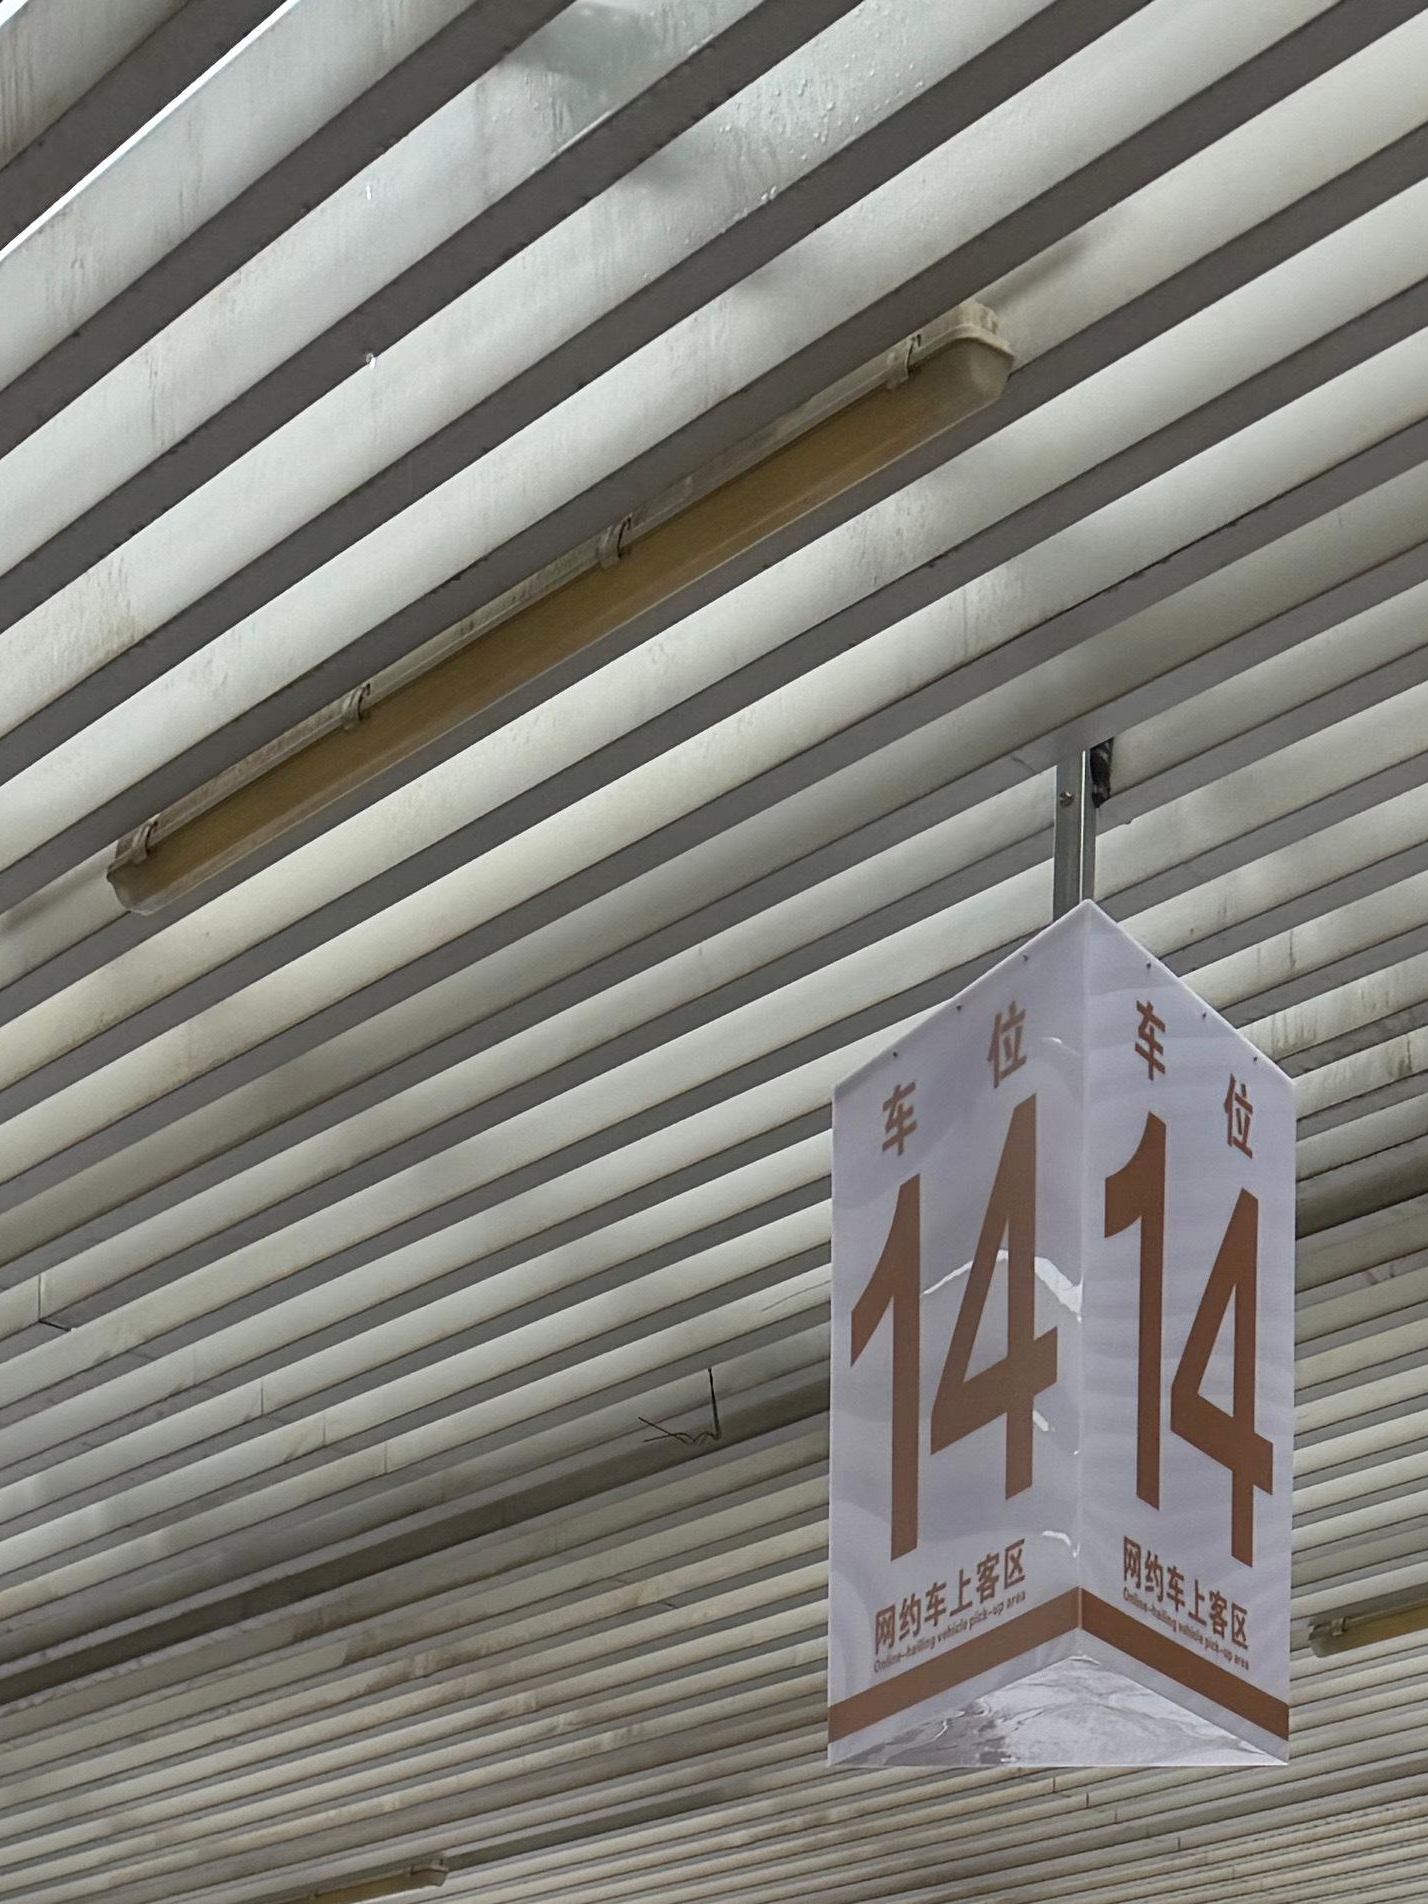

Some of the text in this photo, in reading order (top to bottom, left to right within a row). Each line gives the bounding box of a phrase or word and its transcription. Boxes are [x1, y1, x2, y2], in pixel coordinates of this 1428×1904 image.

[882, 1001, 1028, 1156] 车位
[1134, 1002, 1255, 1160] 车位
[851, 1093, 1058, 1561] 14
[1103, 1110, 1273, 1568] 14
[875, 1538, 1025, 1655] 网约车上客区
[938, 1620, 968, 1643] vehicle
[969, 1602, 1004, 1631] pick-up
[1006, 1591, 1026, 1609] area
[1124, 1536, 1248, 1649] 网约车上客区
